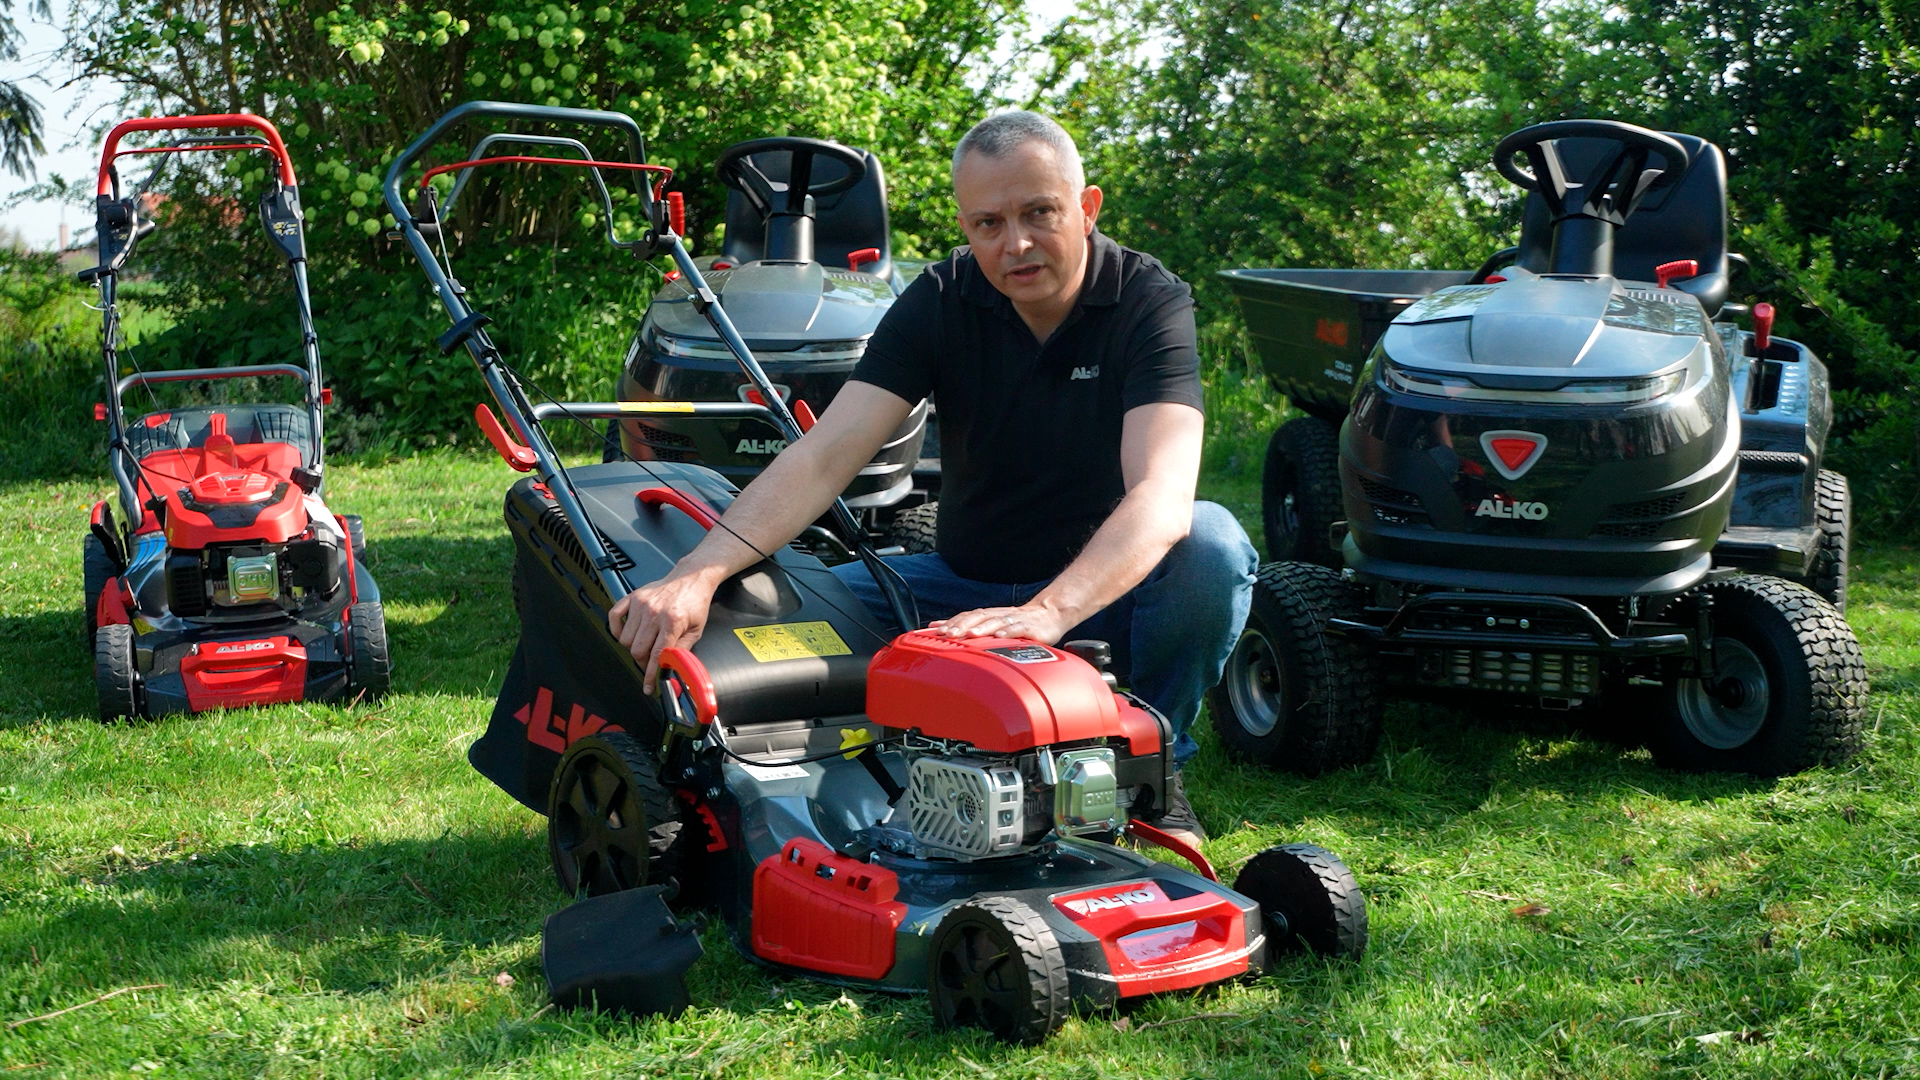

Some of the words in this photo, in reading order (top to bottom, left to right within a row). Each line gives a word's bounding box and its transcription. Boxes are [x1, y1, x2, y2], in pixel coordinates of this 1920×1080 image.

[1475, 499, 1549, 520] AL-KO
[215, 641, 275, 654] AL-KO
[513, 685, 627, 754] L-K
[1085, 889, 1155, 913] AL-KO
